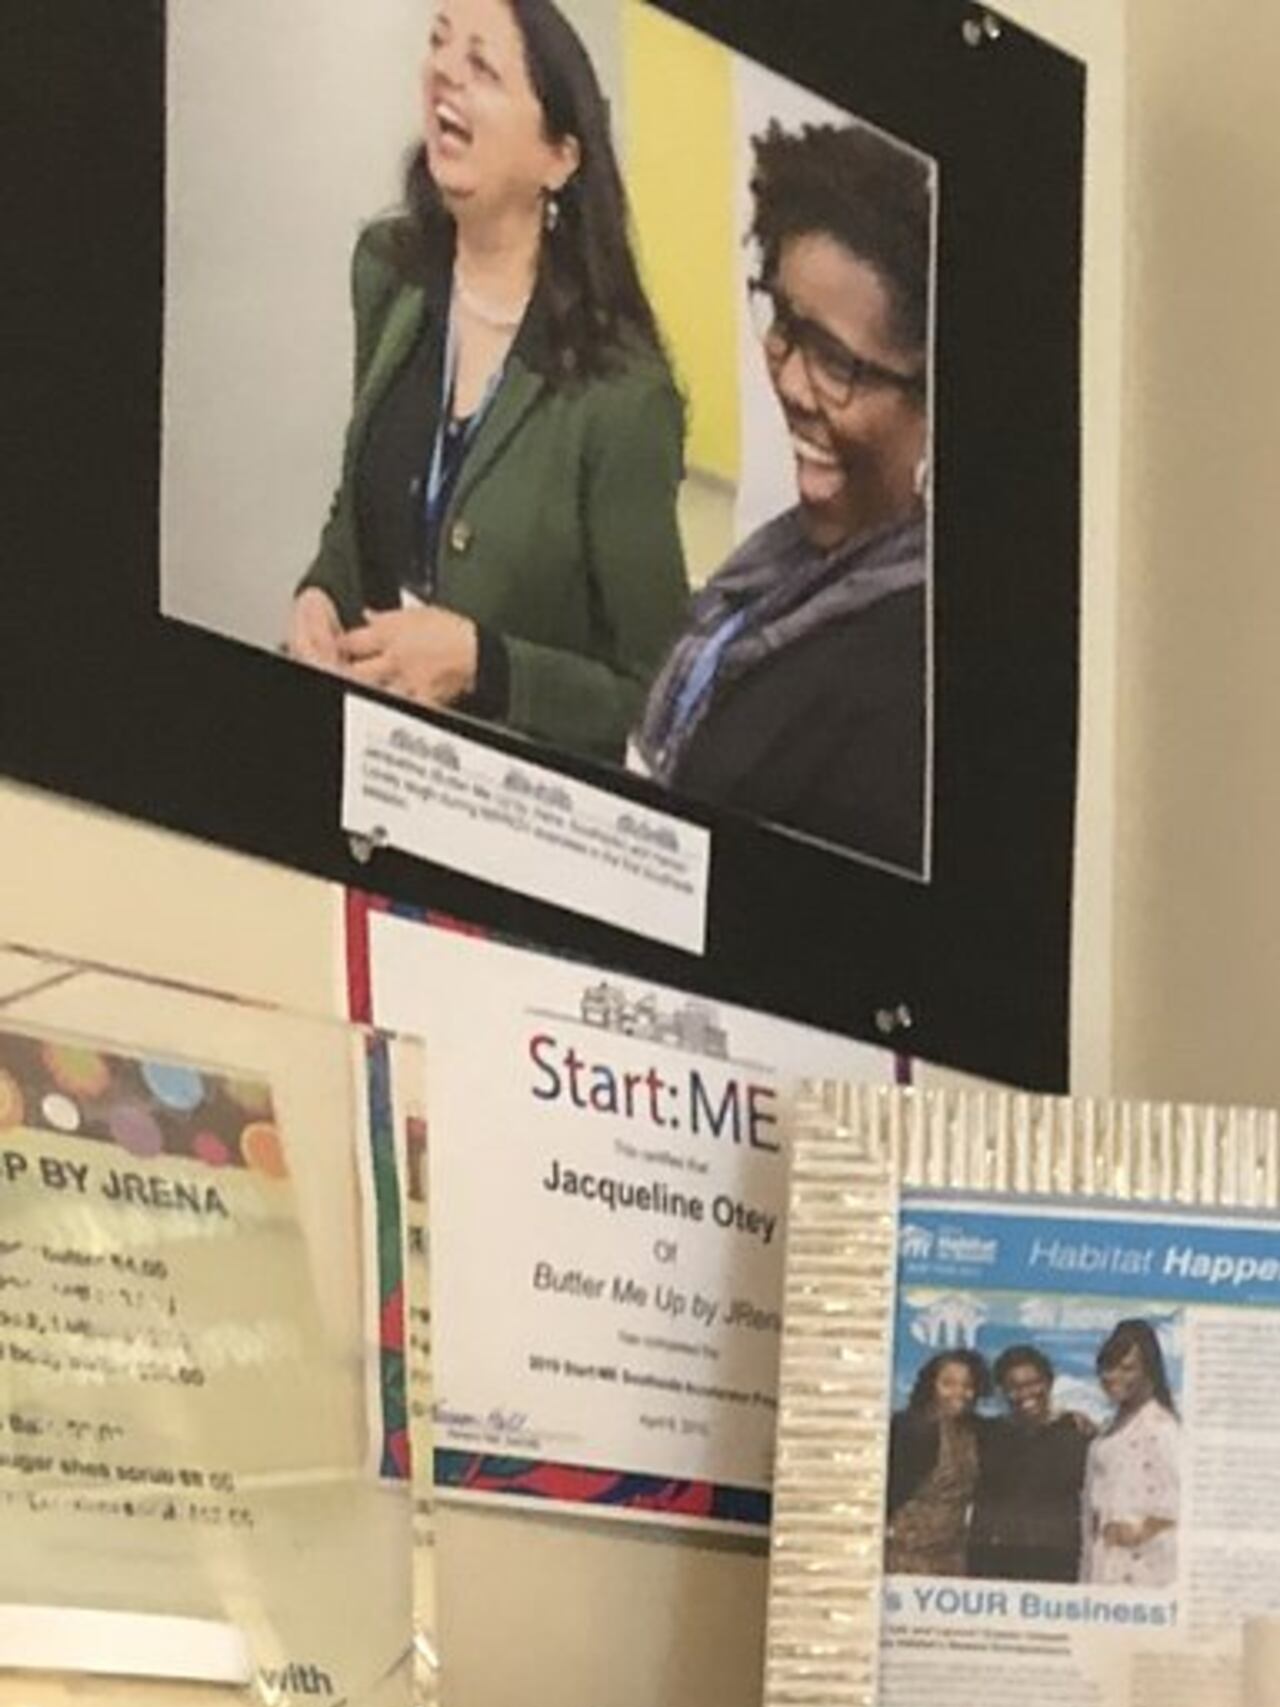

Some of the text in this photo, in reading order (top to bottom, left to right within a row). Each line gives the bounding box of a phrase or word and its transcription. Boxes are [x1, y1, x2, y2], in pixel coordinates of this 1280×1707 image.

[526, 1033, 781, 1153] Start:ME
[0, 1151, 231, 1219] P BY JRENA
[542, 1158, 777, 1245] Jacqueline Otey
[1028, 1238, 1154, 1275] Habitat
[532, 1261, 606, 1300] Butter
[611, 1276, 648, 1308] Me
[654, 1285, 687, 1318] Up
[690, 1294, 719, 1327] by
[914, 1587, 1008, 1617] YOUR
[1018, 1591, 1178, 1626] Business!
[261, 1661, 334, 1697] with
